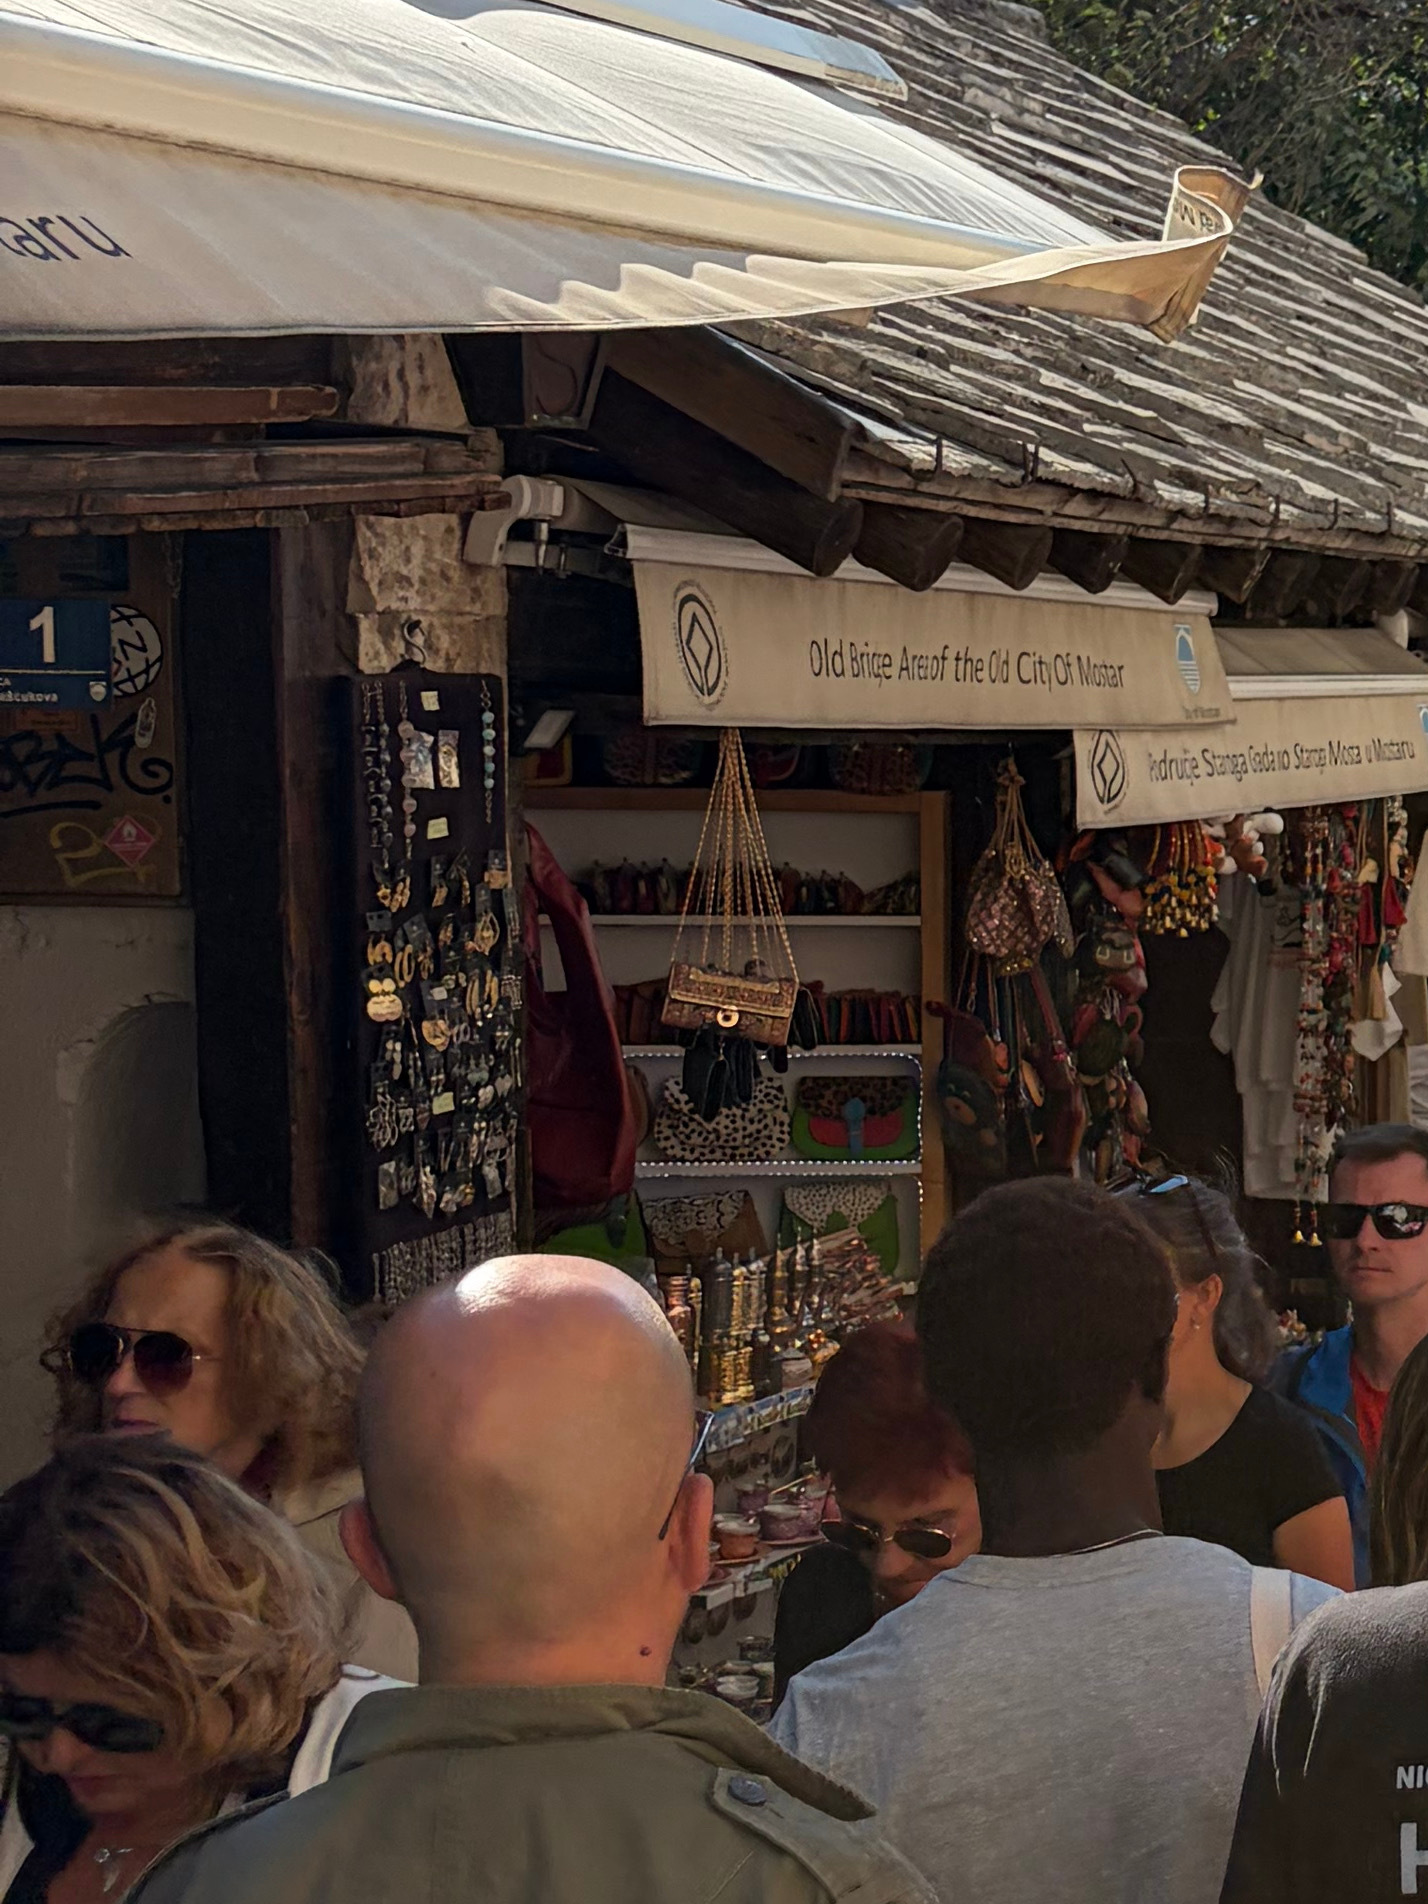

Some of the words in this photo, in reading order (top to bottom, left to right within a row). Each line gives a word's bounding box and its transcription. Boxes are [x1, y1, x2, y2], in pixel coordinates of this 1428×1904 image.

[29, 606, 56, 664] 1
[810, 638, 845, 679] Old
[954, 646, 984, 684] the
[1017, 650, 1053, 693] City
[1055, 653, 1074, 686] Of
[1078, 654, 1124, 689] Mostar
